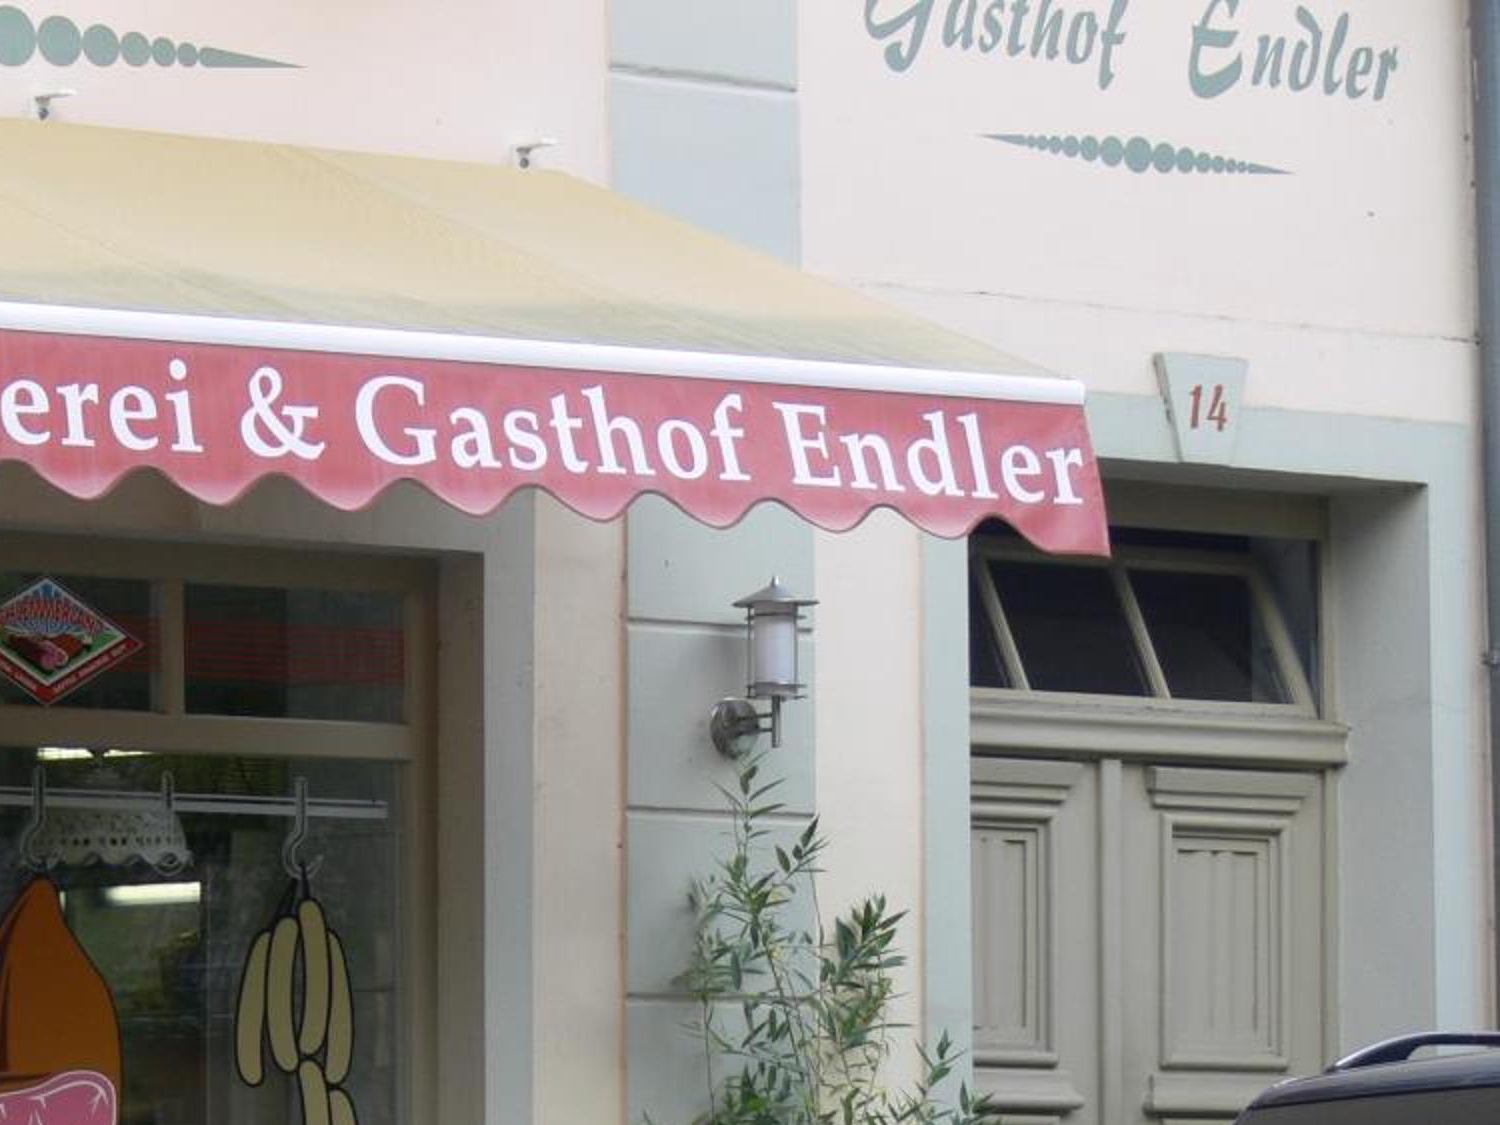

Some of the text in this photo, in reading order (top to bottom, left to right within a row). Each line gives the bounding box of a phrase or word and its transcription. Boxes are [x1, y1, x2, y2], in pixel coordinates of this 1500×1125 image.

[1188, 0, 1399, 100] Endler
[240, 366, 326, 460] &
[355, 374, 753, 483] Gasthof
[772, 400, 1085, 506] Endler
[1188, 384, 1228, 432] 14
